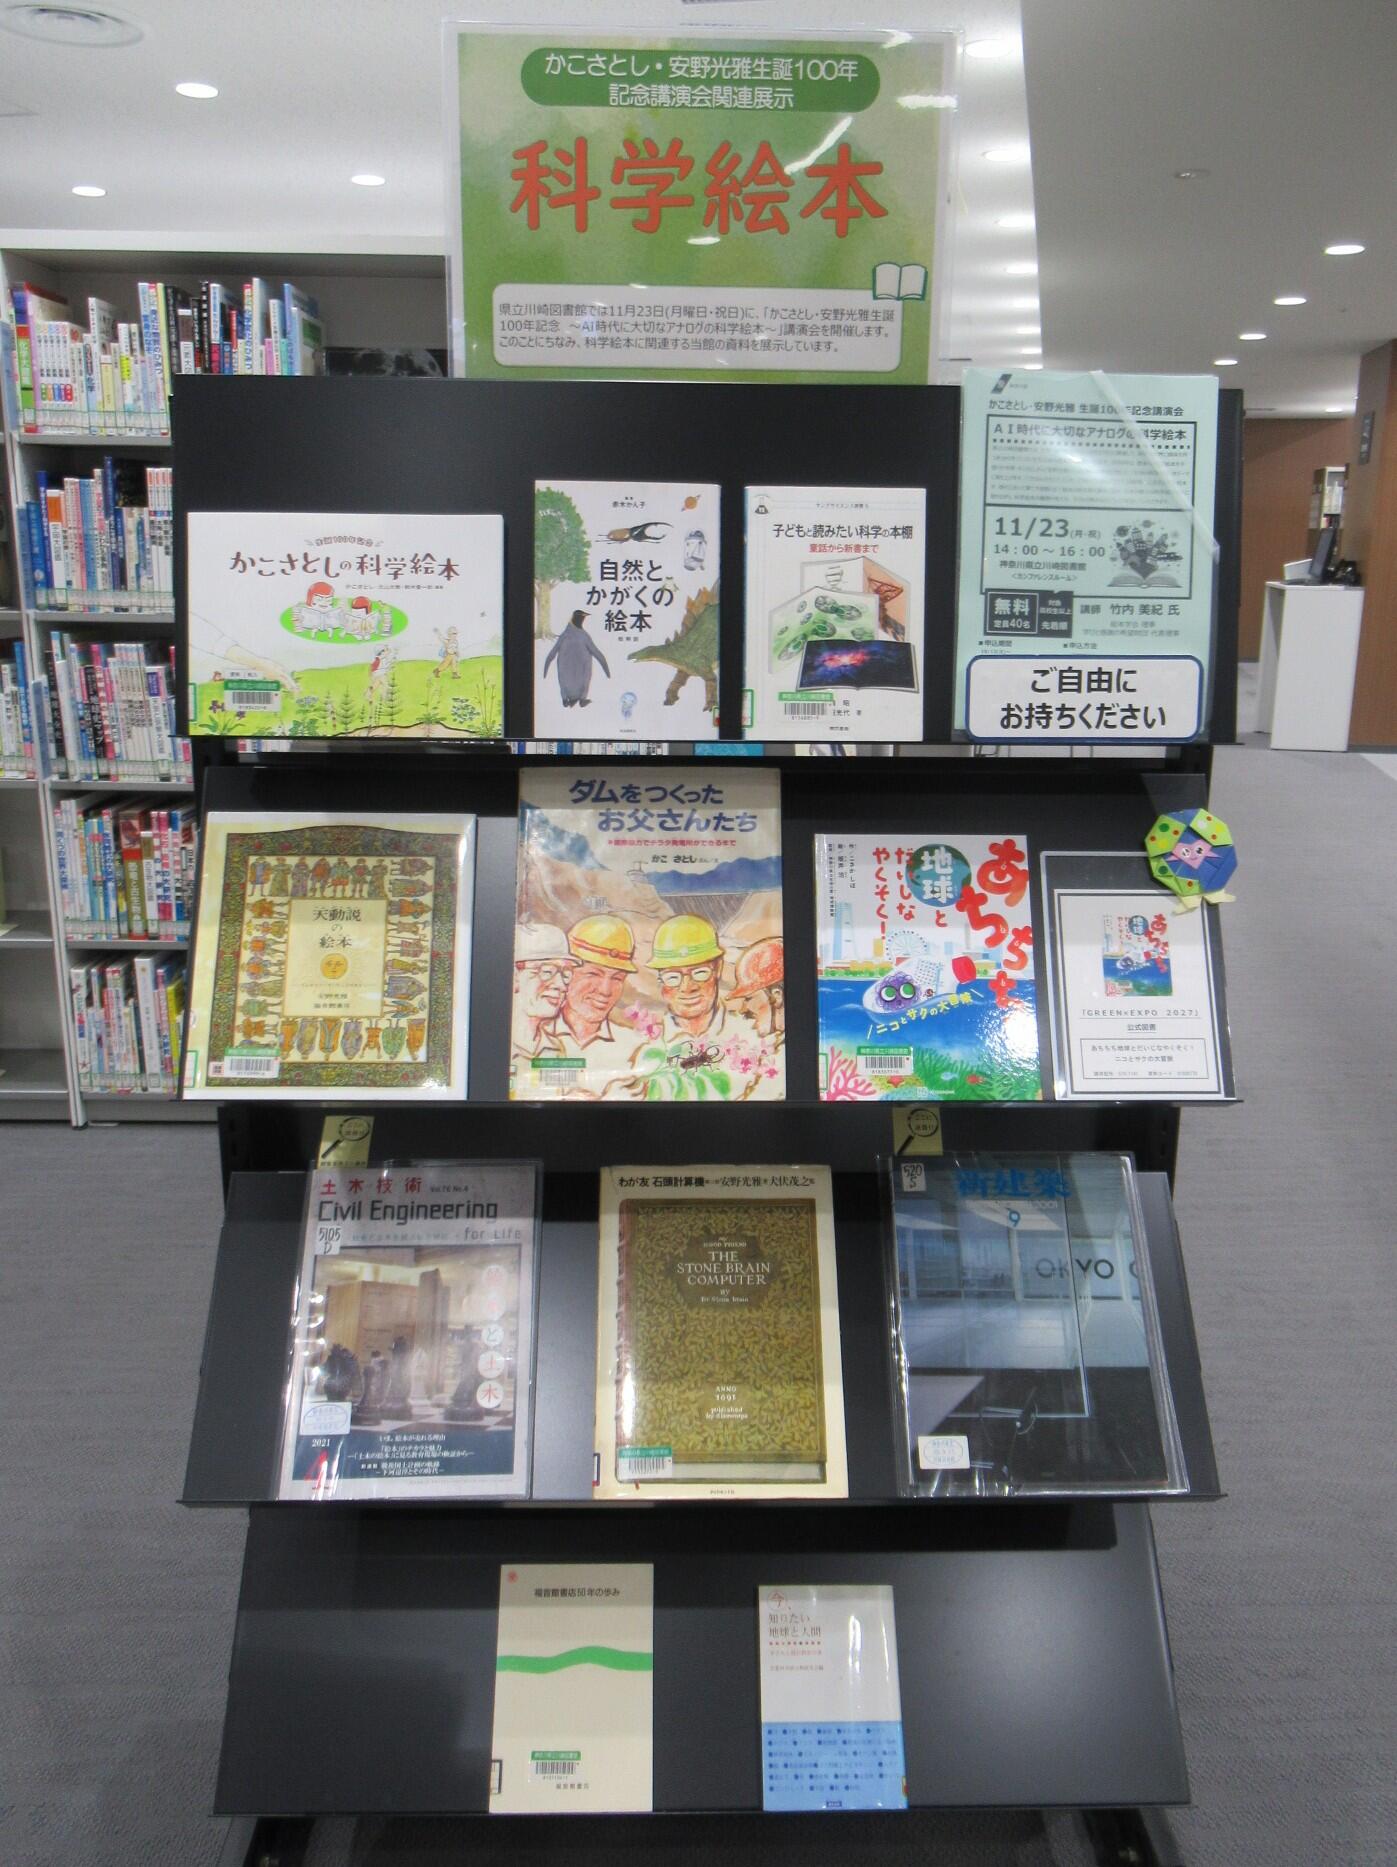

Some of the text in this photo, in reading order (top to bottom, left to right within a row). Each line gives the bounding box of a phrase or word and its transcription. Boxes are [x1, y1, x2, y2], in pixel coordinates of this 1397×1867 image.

[544, 52, 859, 82] かこさとし・安野光雅生誕100年
[609, 83, 794, 110] 記念講演会関連展示
[510, 136, 888, 239] 科学絵本
[772, 523, 913, 540] 子どもと読みたい科学の本棚
[994, 517, 1069, 540] 11/23
[809, 543, 879, 553] 童話から新書まで
[229, 551, 461, 581] かこさとしの科学絵本
[599, 558, 663, 582] 自然と
[586, 585, 674, 607] かがくの
[994, 598, 1030, 616] 無料
[1080, 603, 1180, 616] 講師 竹内 美紀 氏
[604, 609, 652, 633] 絵本
[1041, 621, 1068, 631] 先着順
[1031, 666, 1137, 694] ご自由に
[999, 702, 1166, 730] お持ちください
[568, 780, 724, 805] ダムをつくった
[597, 808, 759, 834] お父さんたち
[651, 855, 667, 864] かこ
[673, 855, 697, 864] さとし
[920, 846, 954, 904] 地球
[312, 906, 362, 922] 天動説
[935, 909, 948, 928] と
[319, 935, 352, 949] 絵本
[903, 1165, 923, 1178] 520
[320, 1176, 423, 1196] 土木技術
[618, 1176, 650, 1187] わが友
[652, 1176, 705, 1187] 石頭計算機
[955, 1166, 1072, 1199] 新建築
[317, 1200, 498, 1226] Civil Engineering
[318, 1227, 342, 1242] 5105
[464, 1227, 486, 1240] for
[707, 1250, 739, 1262] THE
[677, 1262, 771, 1275] STONE BRAIN
[687, 1274, 767, 1286] COMPUTER
[311, 1438, 331, 1448] 2021
[768, 1613, 811, 1624] 知りたい
[769, 1626, 821, 1638] 地球と人間
